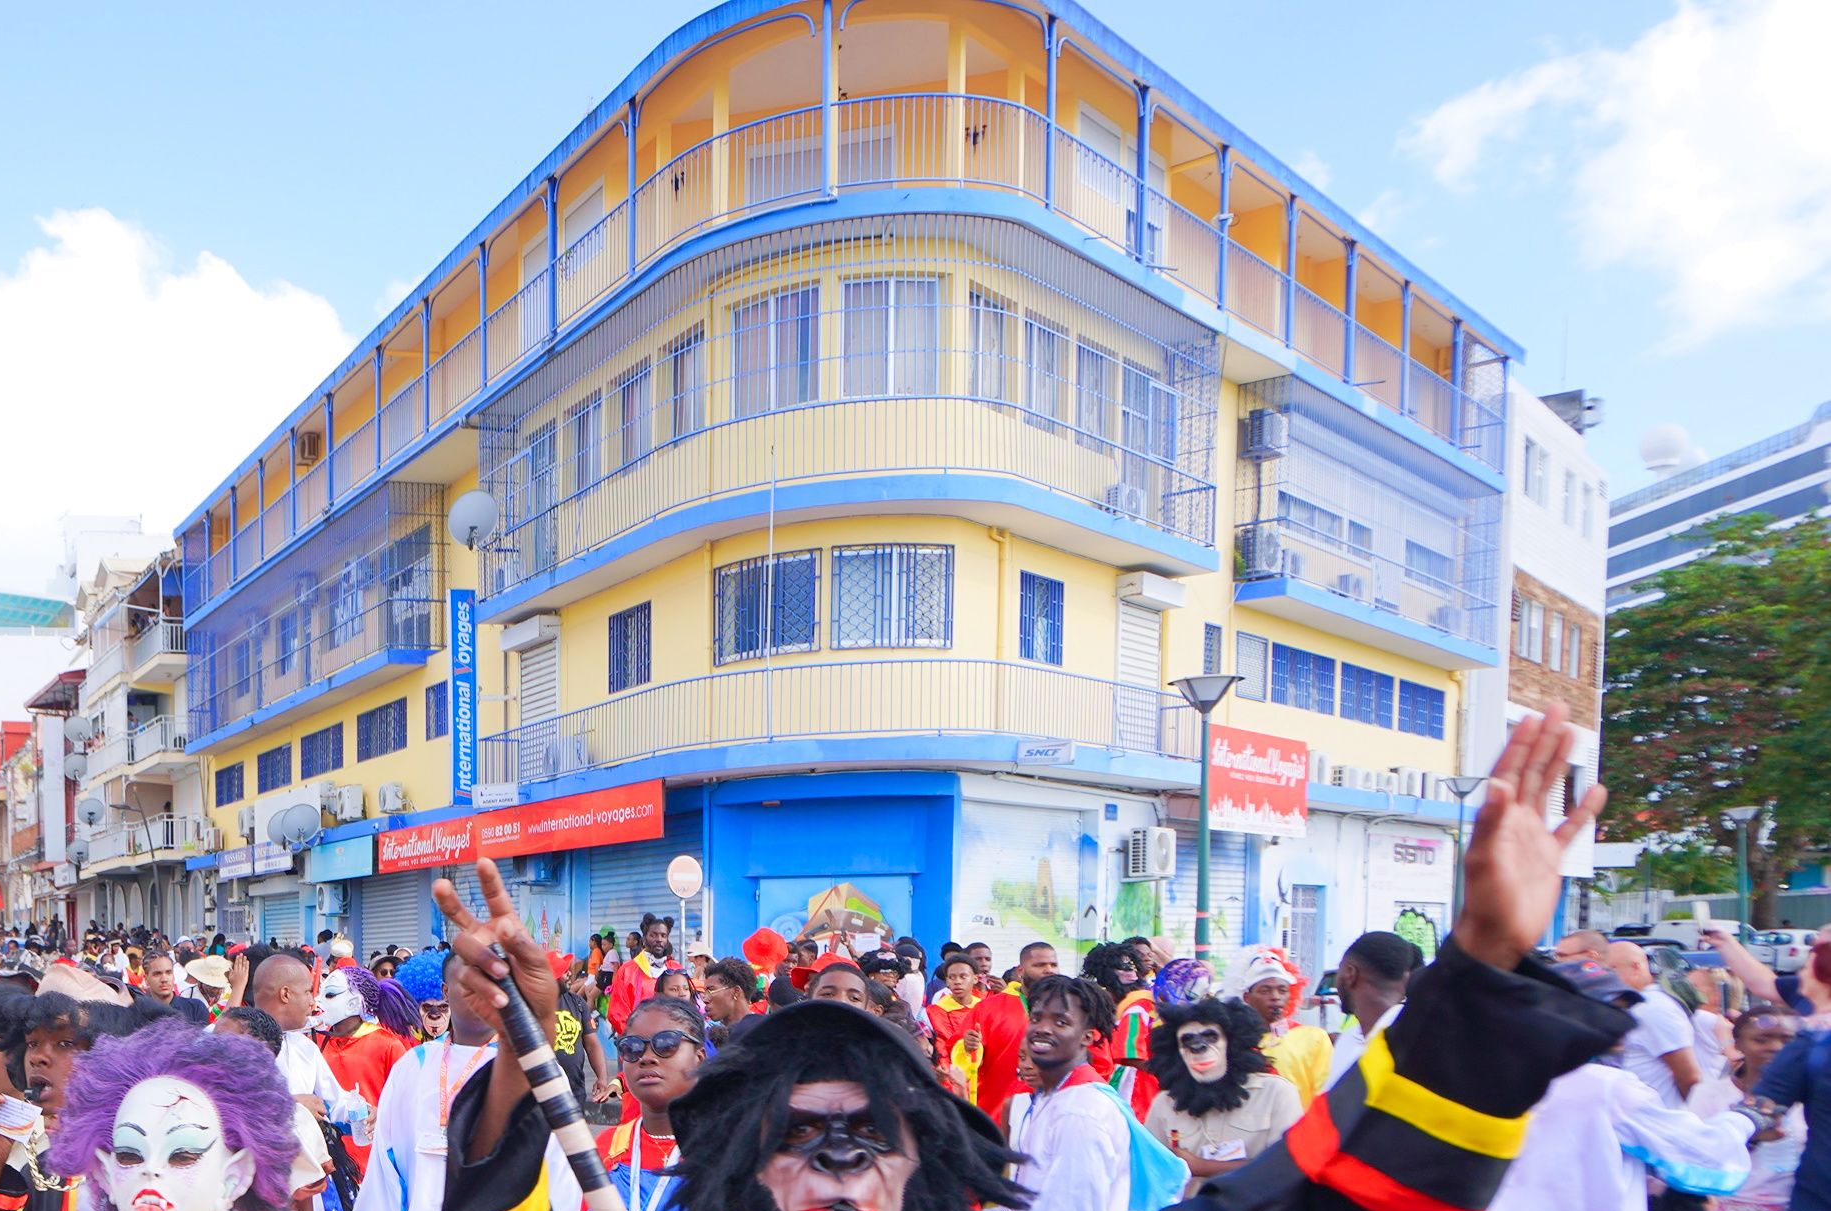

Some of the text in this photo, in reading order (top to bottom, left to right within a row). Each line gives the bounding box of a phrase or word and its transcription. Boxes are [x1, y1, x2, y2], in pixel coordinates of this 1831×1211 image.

[454, 600, 473, 798] International Voyages
[1025, 748, 1062, 757] SNCF
[495, 824, 504, 837] 82
[503, 822, 513, 836] 00
[512, 821, 521, 834] 51
[382, 826, 471, 862] International Voyages
